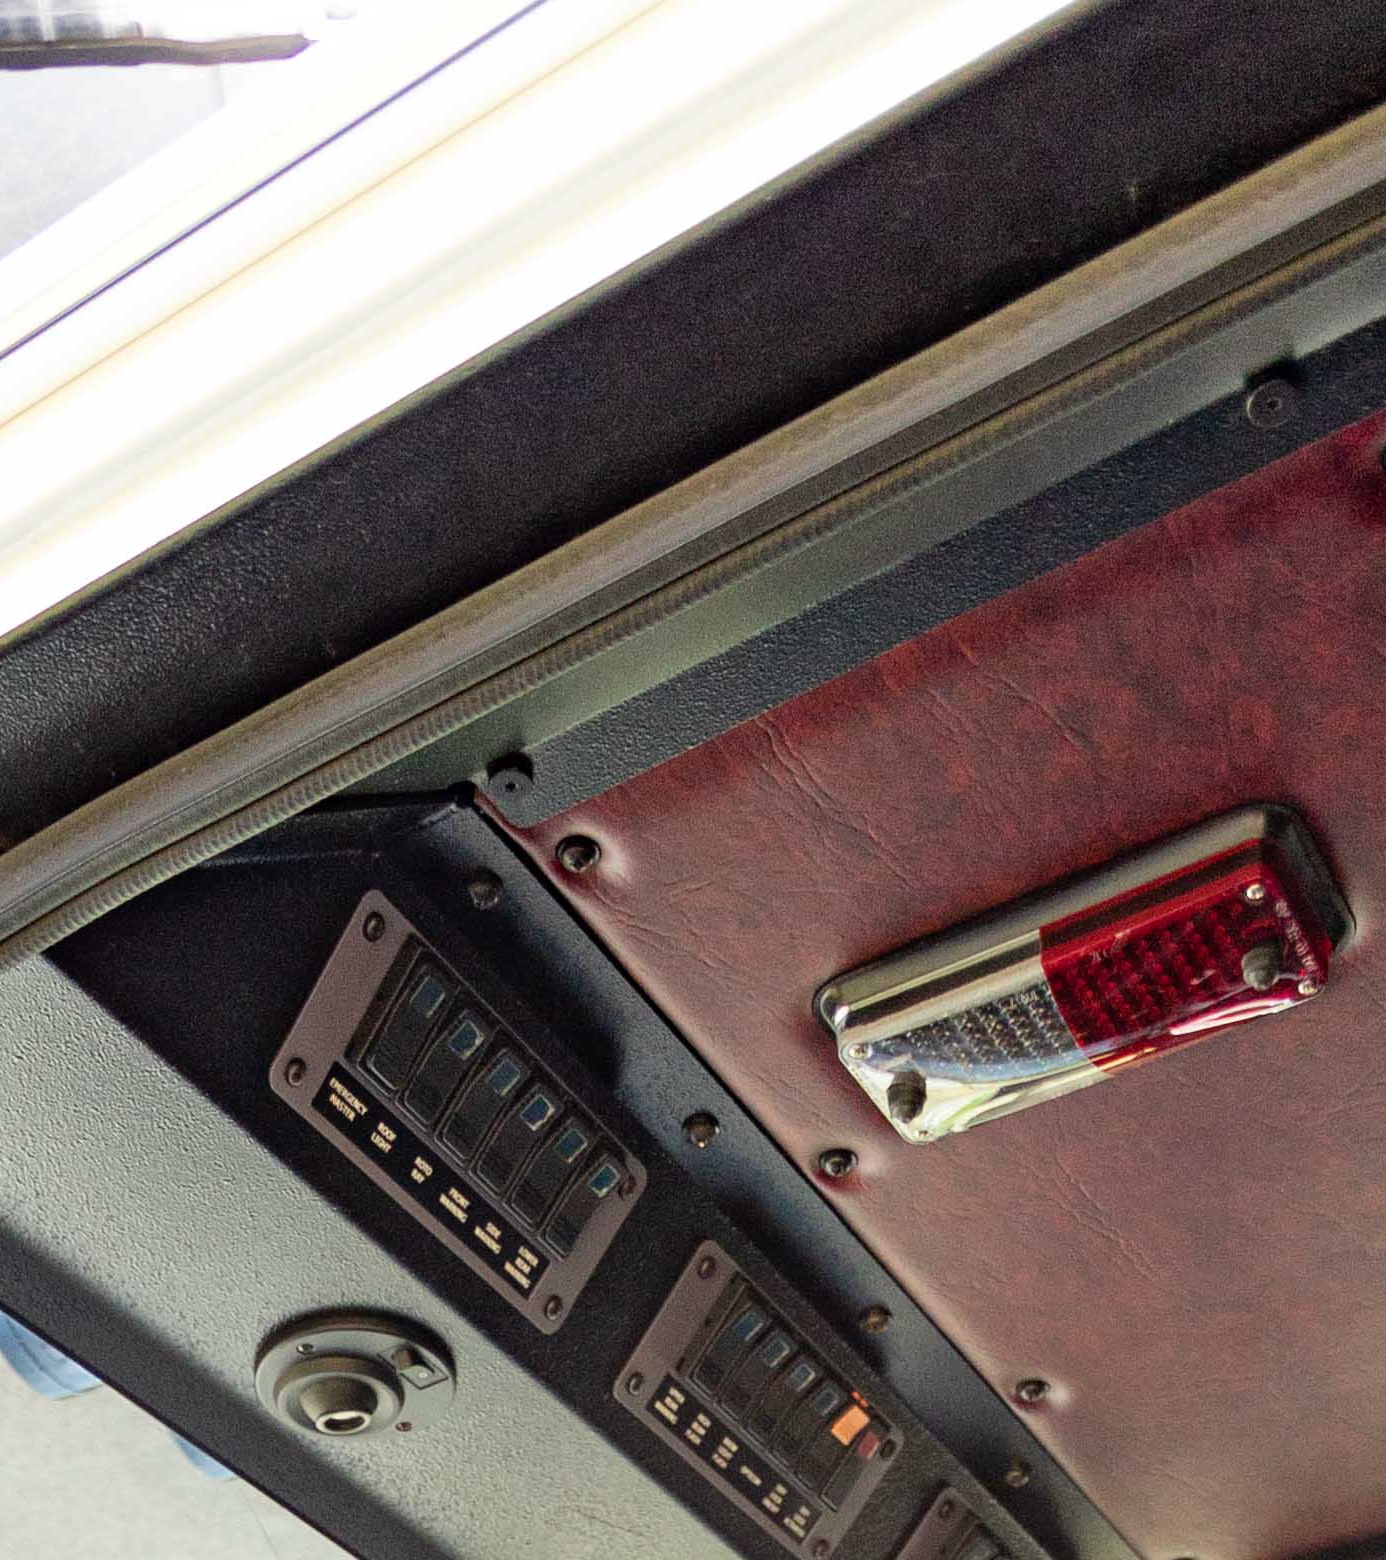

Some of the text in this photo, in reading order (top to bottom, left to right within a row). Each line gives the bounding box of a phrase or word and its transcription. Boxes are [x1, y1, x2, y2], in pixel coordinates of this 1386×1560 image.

[329, 1077, 368, 1115] EMERGENCY
[329, 1094, 356, 1122] MASTER
[370, 1133, 392, 1154] LIGHT
